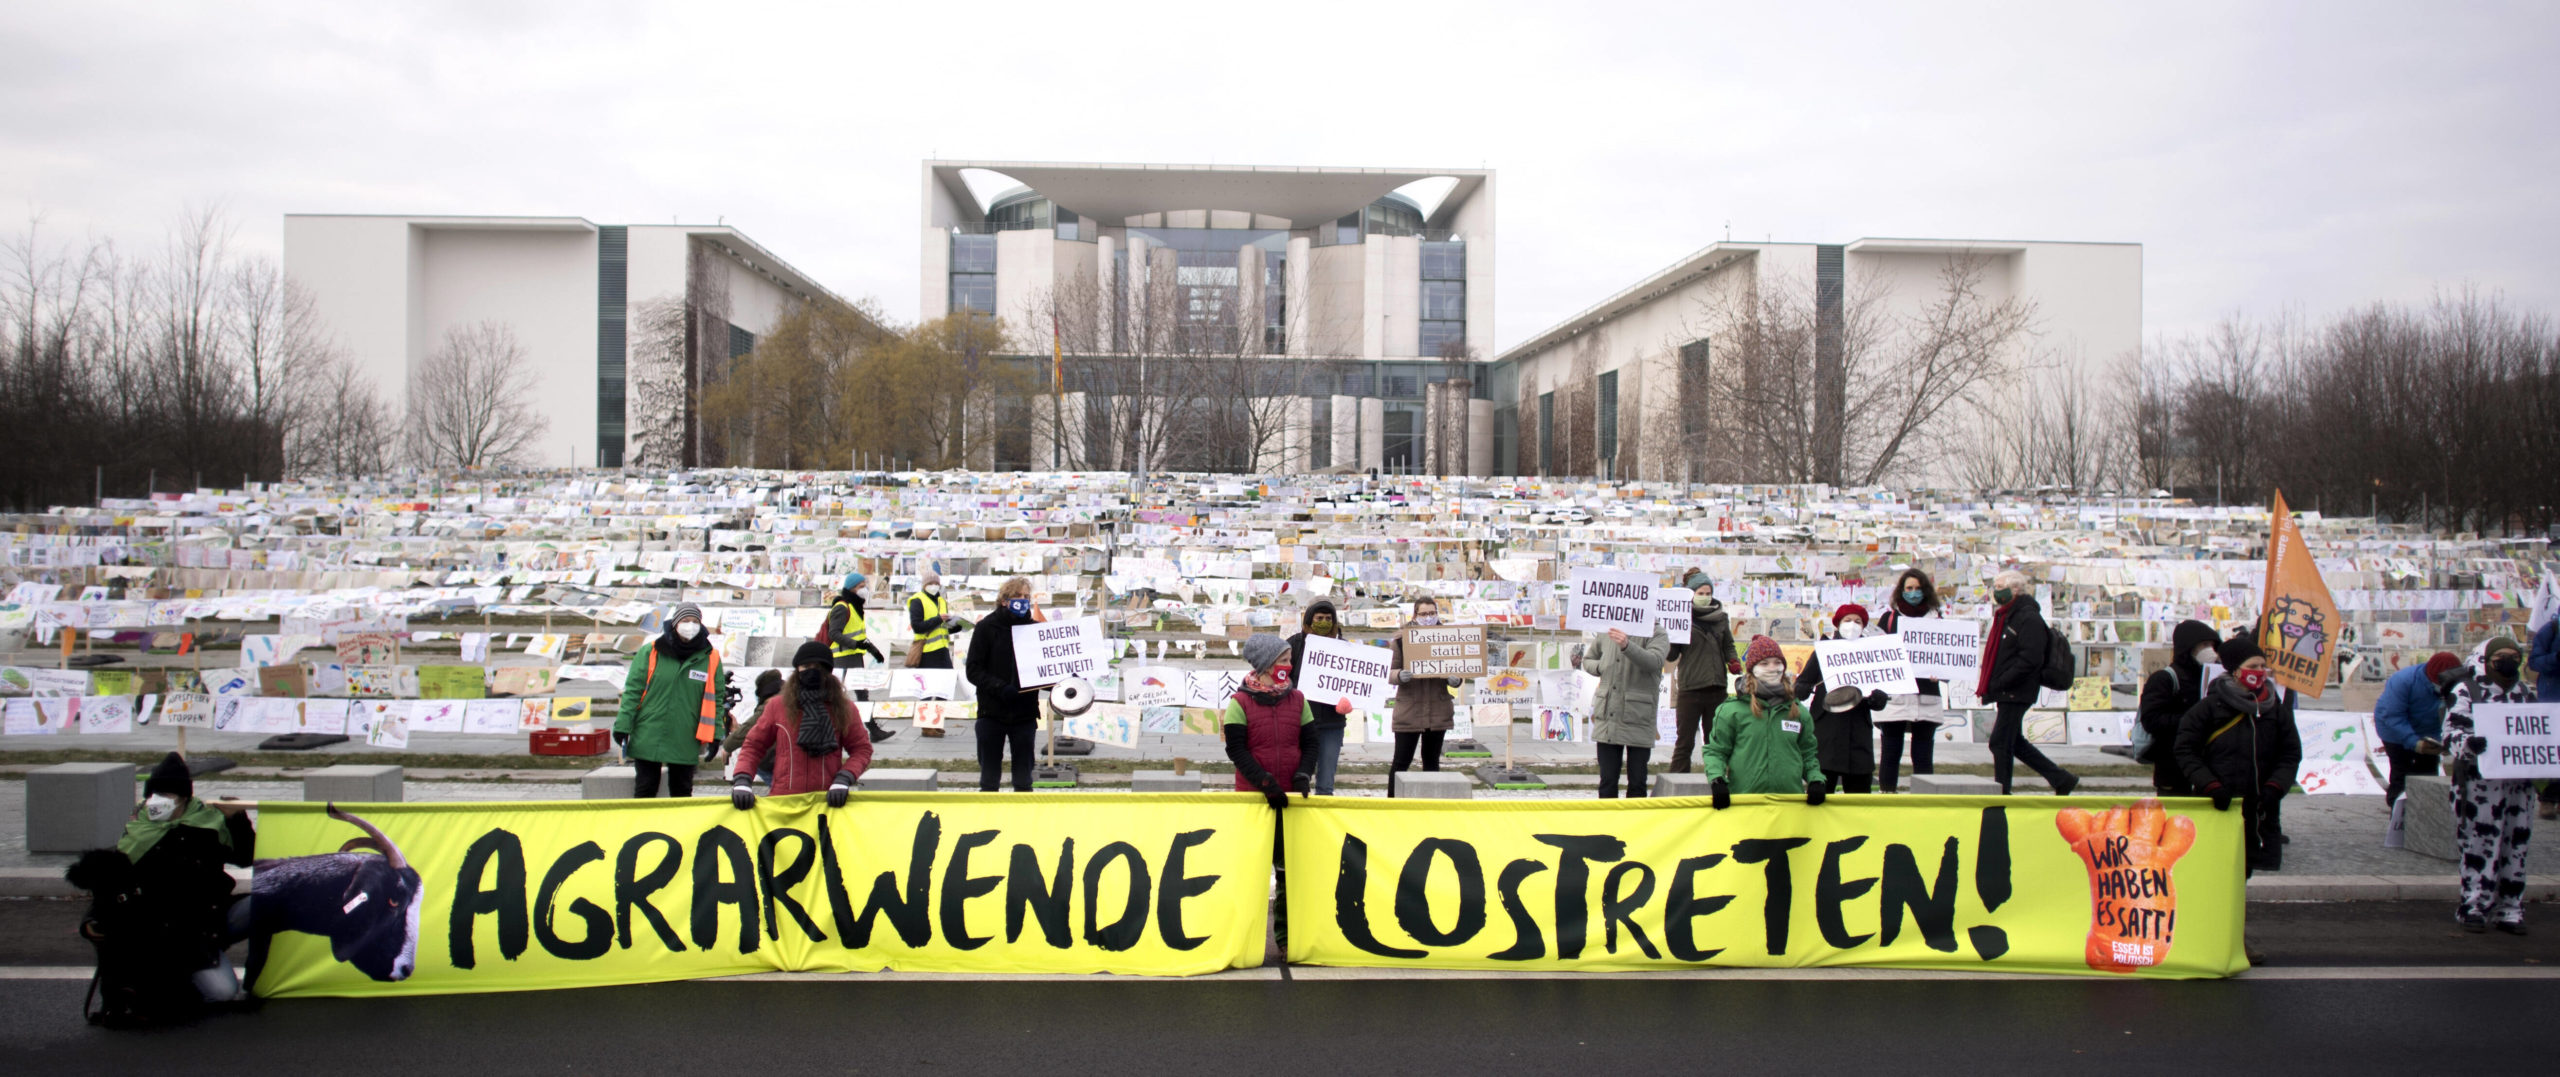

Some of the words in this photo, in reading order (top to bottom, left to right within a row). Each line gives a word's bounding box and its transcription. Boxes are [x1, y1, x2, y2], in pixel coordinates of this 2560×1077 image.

[1582, 580, 1649, 600] LANDRAUB
[1582, 603, 1644, 623] BEENDEN!
[1038, 625, 1080, 641] BAUERN
[1410, 629, 1480, 643] Pastinaken
[1903, 630, 1977, 648] ARTGERECHTE
[1042, 642, 1082, 659] RECHTE
[1432, 645, 1460, 656] statt
[1826, 647, 1905, 668] AGRARWENDE
[1037, 658, 1094, 678] WELTWEIT!
[1308, 650, 1388, 679] HÖFESTERBEN
[1412, 660, 1482, 674] PESTiziden
[1317, 674, 1372, 698] STOPPEN!
[1836, 667, 1905, 686] LOSTRETEN!
[2505, 715, 2551, 735] FAIRE
[449, 810, 1222, 970] AGRARWENDE
[1334, 805, 2012, 962] LOSTRETEN!
[2098, 868, 2169, 899] HABEN
[2097, 901, 2116, 926] ES
[2117, 907, 2175, 943] SATT!
[2112, 941, 2141, 954] ESSEN
[2142, 944, 2154, 955] IST
[2113, 953, 2154, 965] POLITISCH
